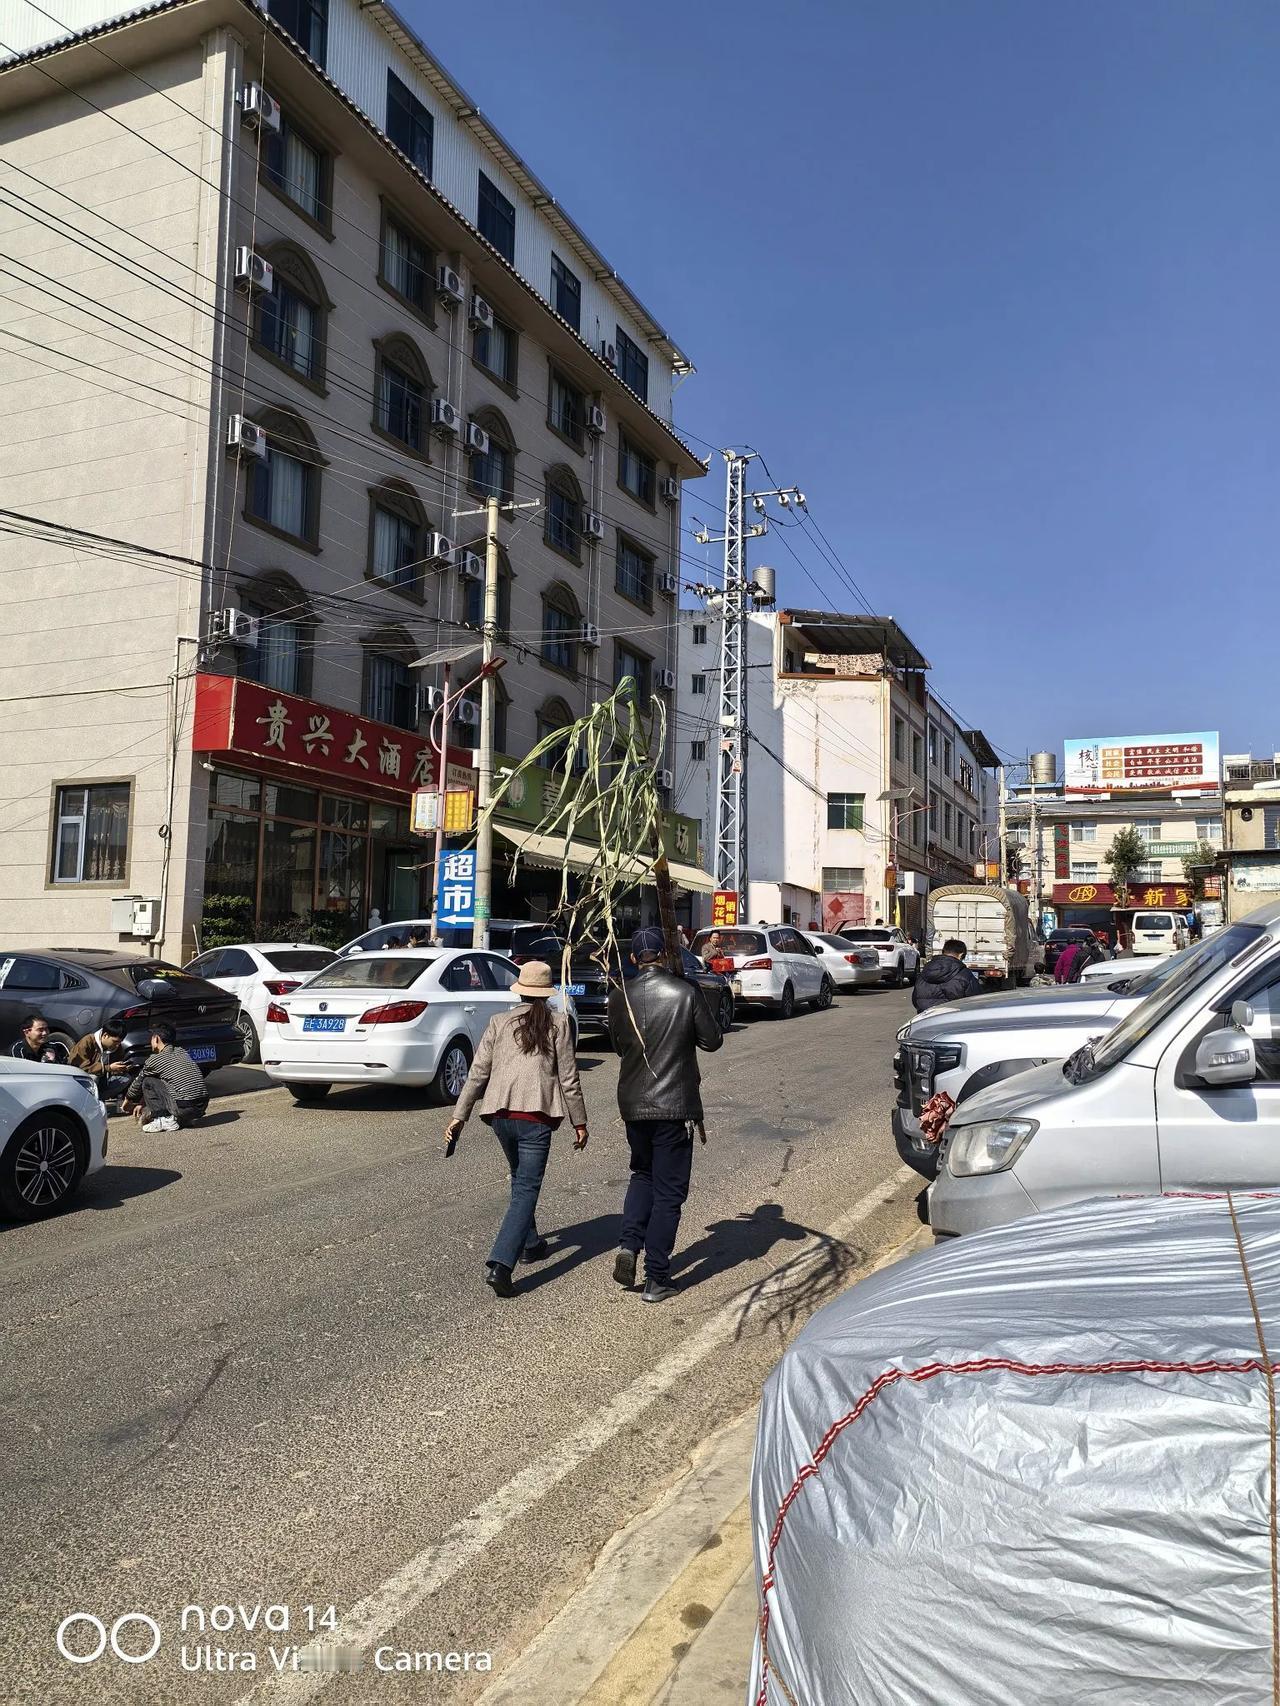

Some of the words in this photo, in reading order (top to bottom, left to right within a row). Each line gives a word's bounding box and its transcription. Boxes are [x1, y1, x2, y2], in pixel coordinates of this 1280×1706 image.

[255, 698, 436, 786] 贵兴大酒店
[1078, 749, 1099, 769] 核心
[443, 853, 474, 912] 超市
[725, 901, 736, 924] 销售
